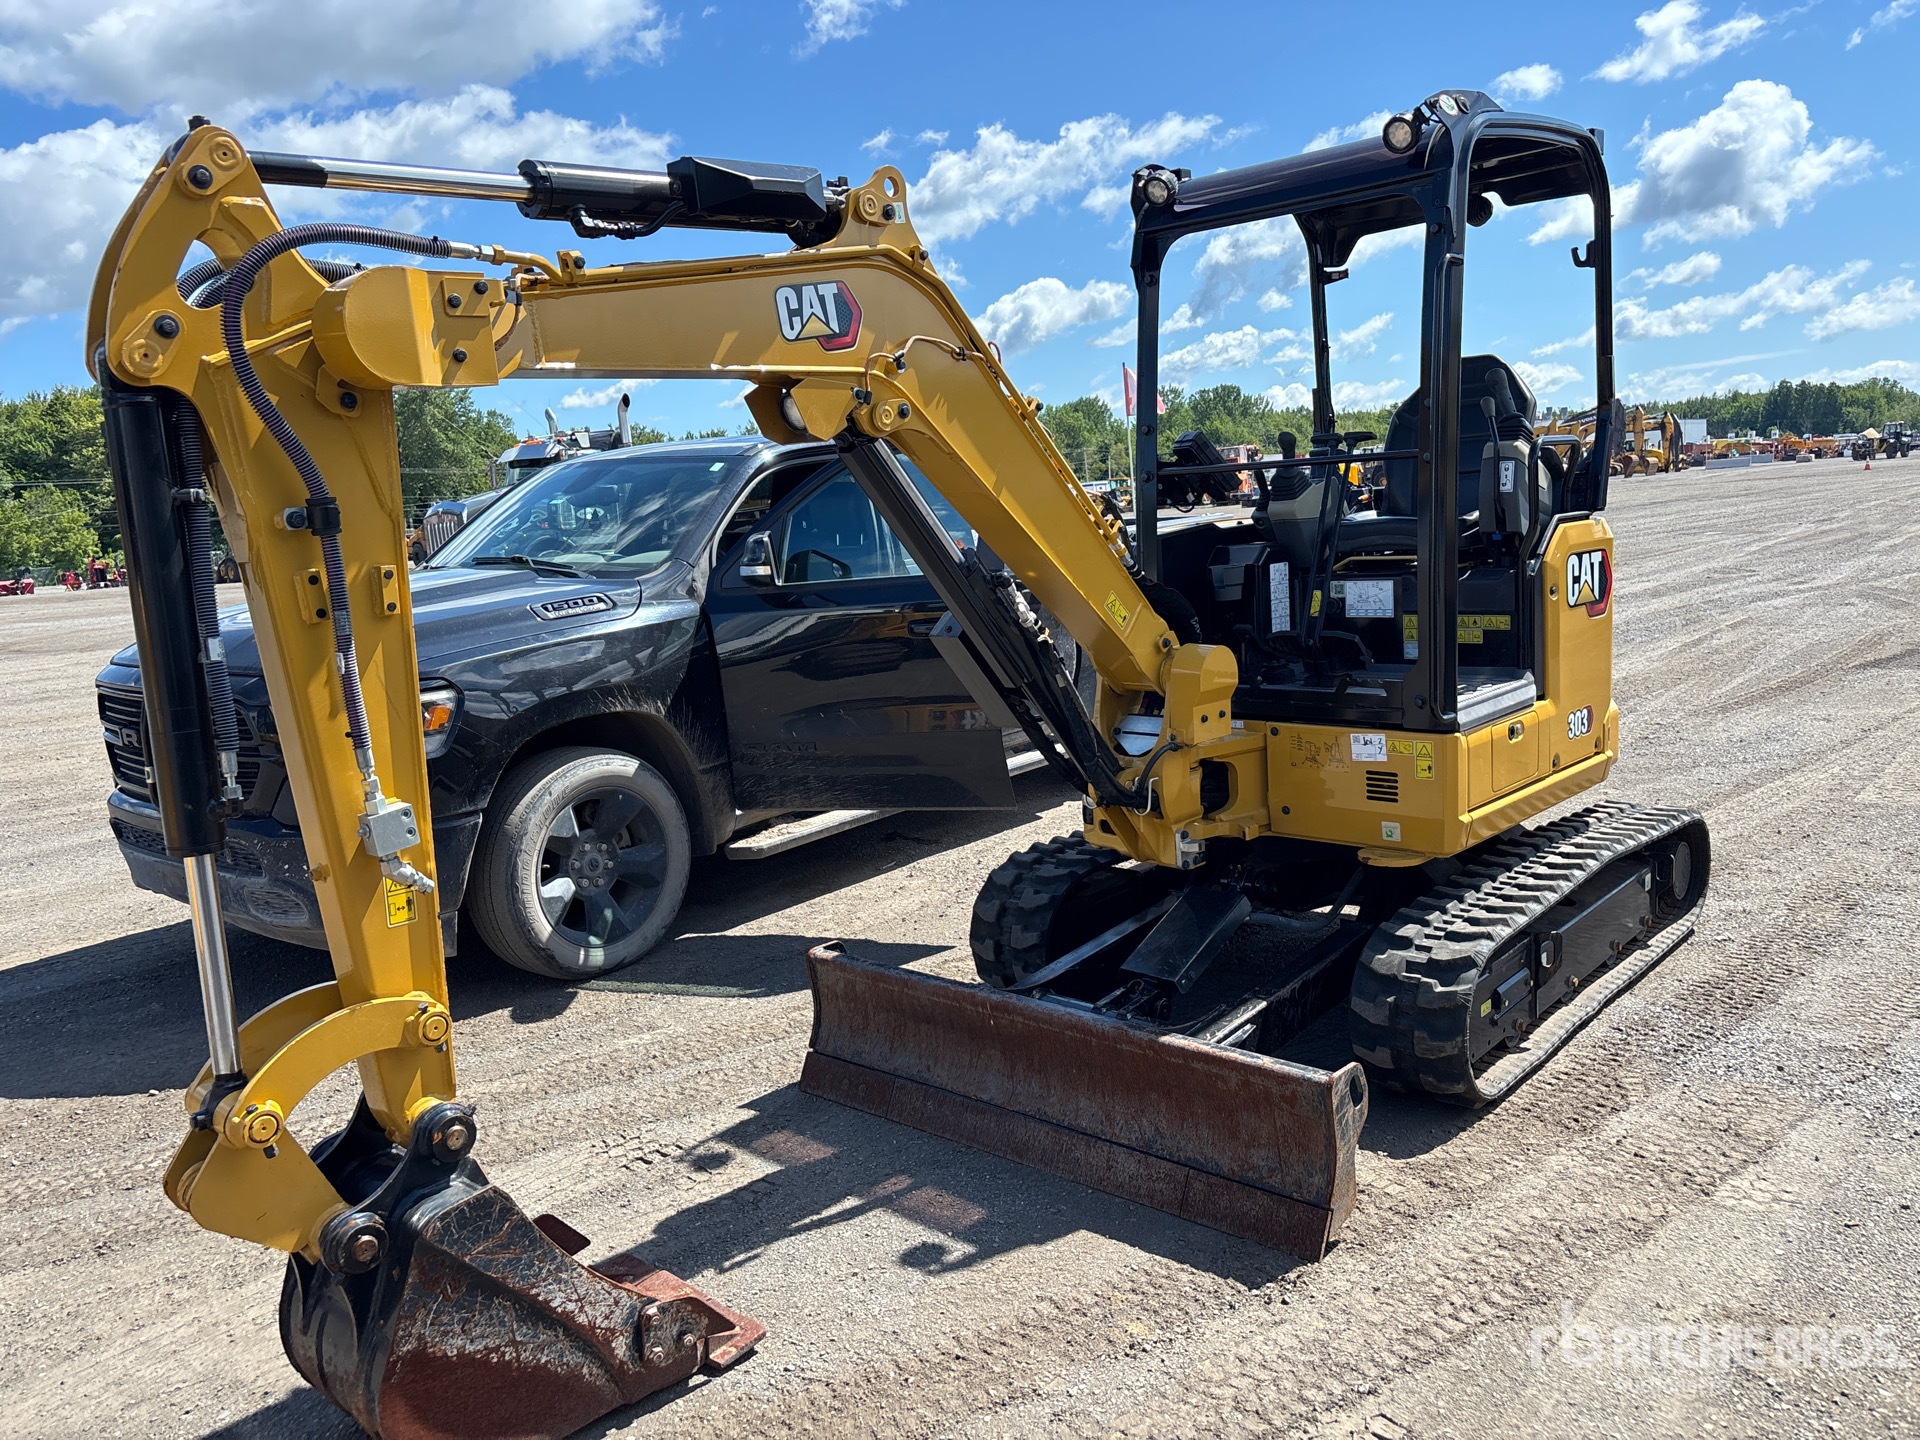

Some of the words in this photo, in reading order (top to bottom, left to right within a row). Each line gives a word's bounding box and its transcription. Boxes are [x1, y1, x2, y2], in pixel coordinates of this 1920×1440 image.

[775, 282, 840, 340] CAT
[1567, 551, 1602, 606] CAT
[542, 596, 599, 612] 1500
[1568, 708, 1588, 739] 303
